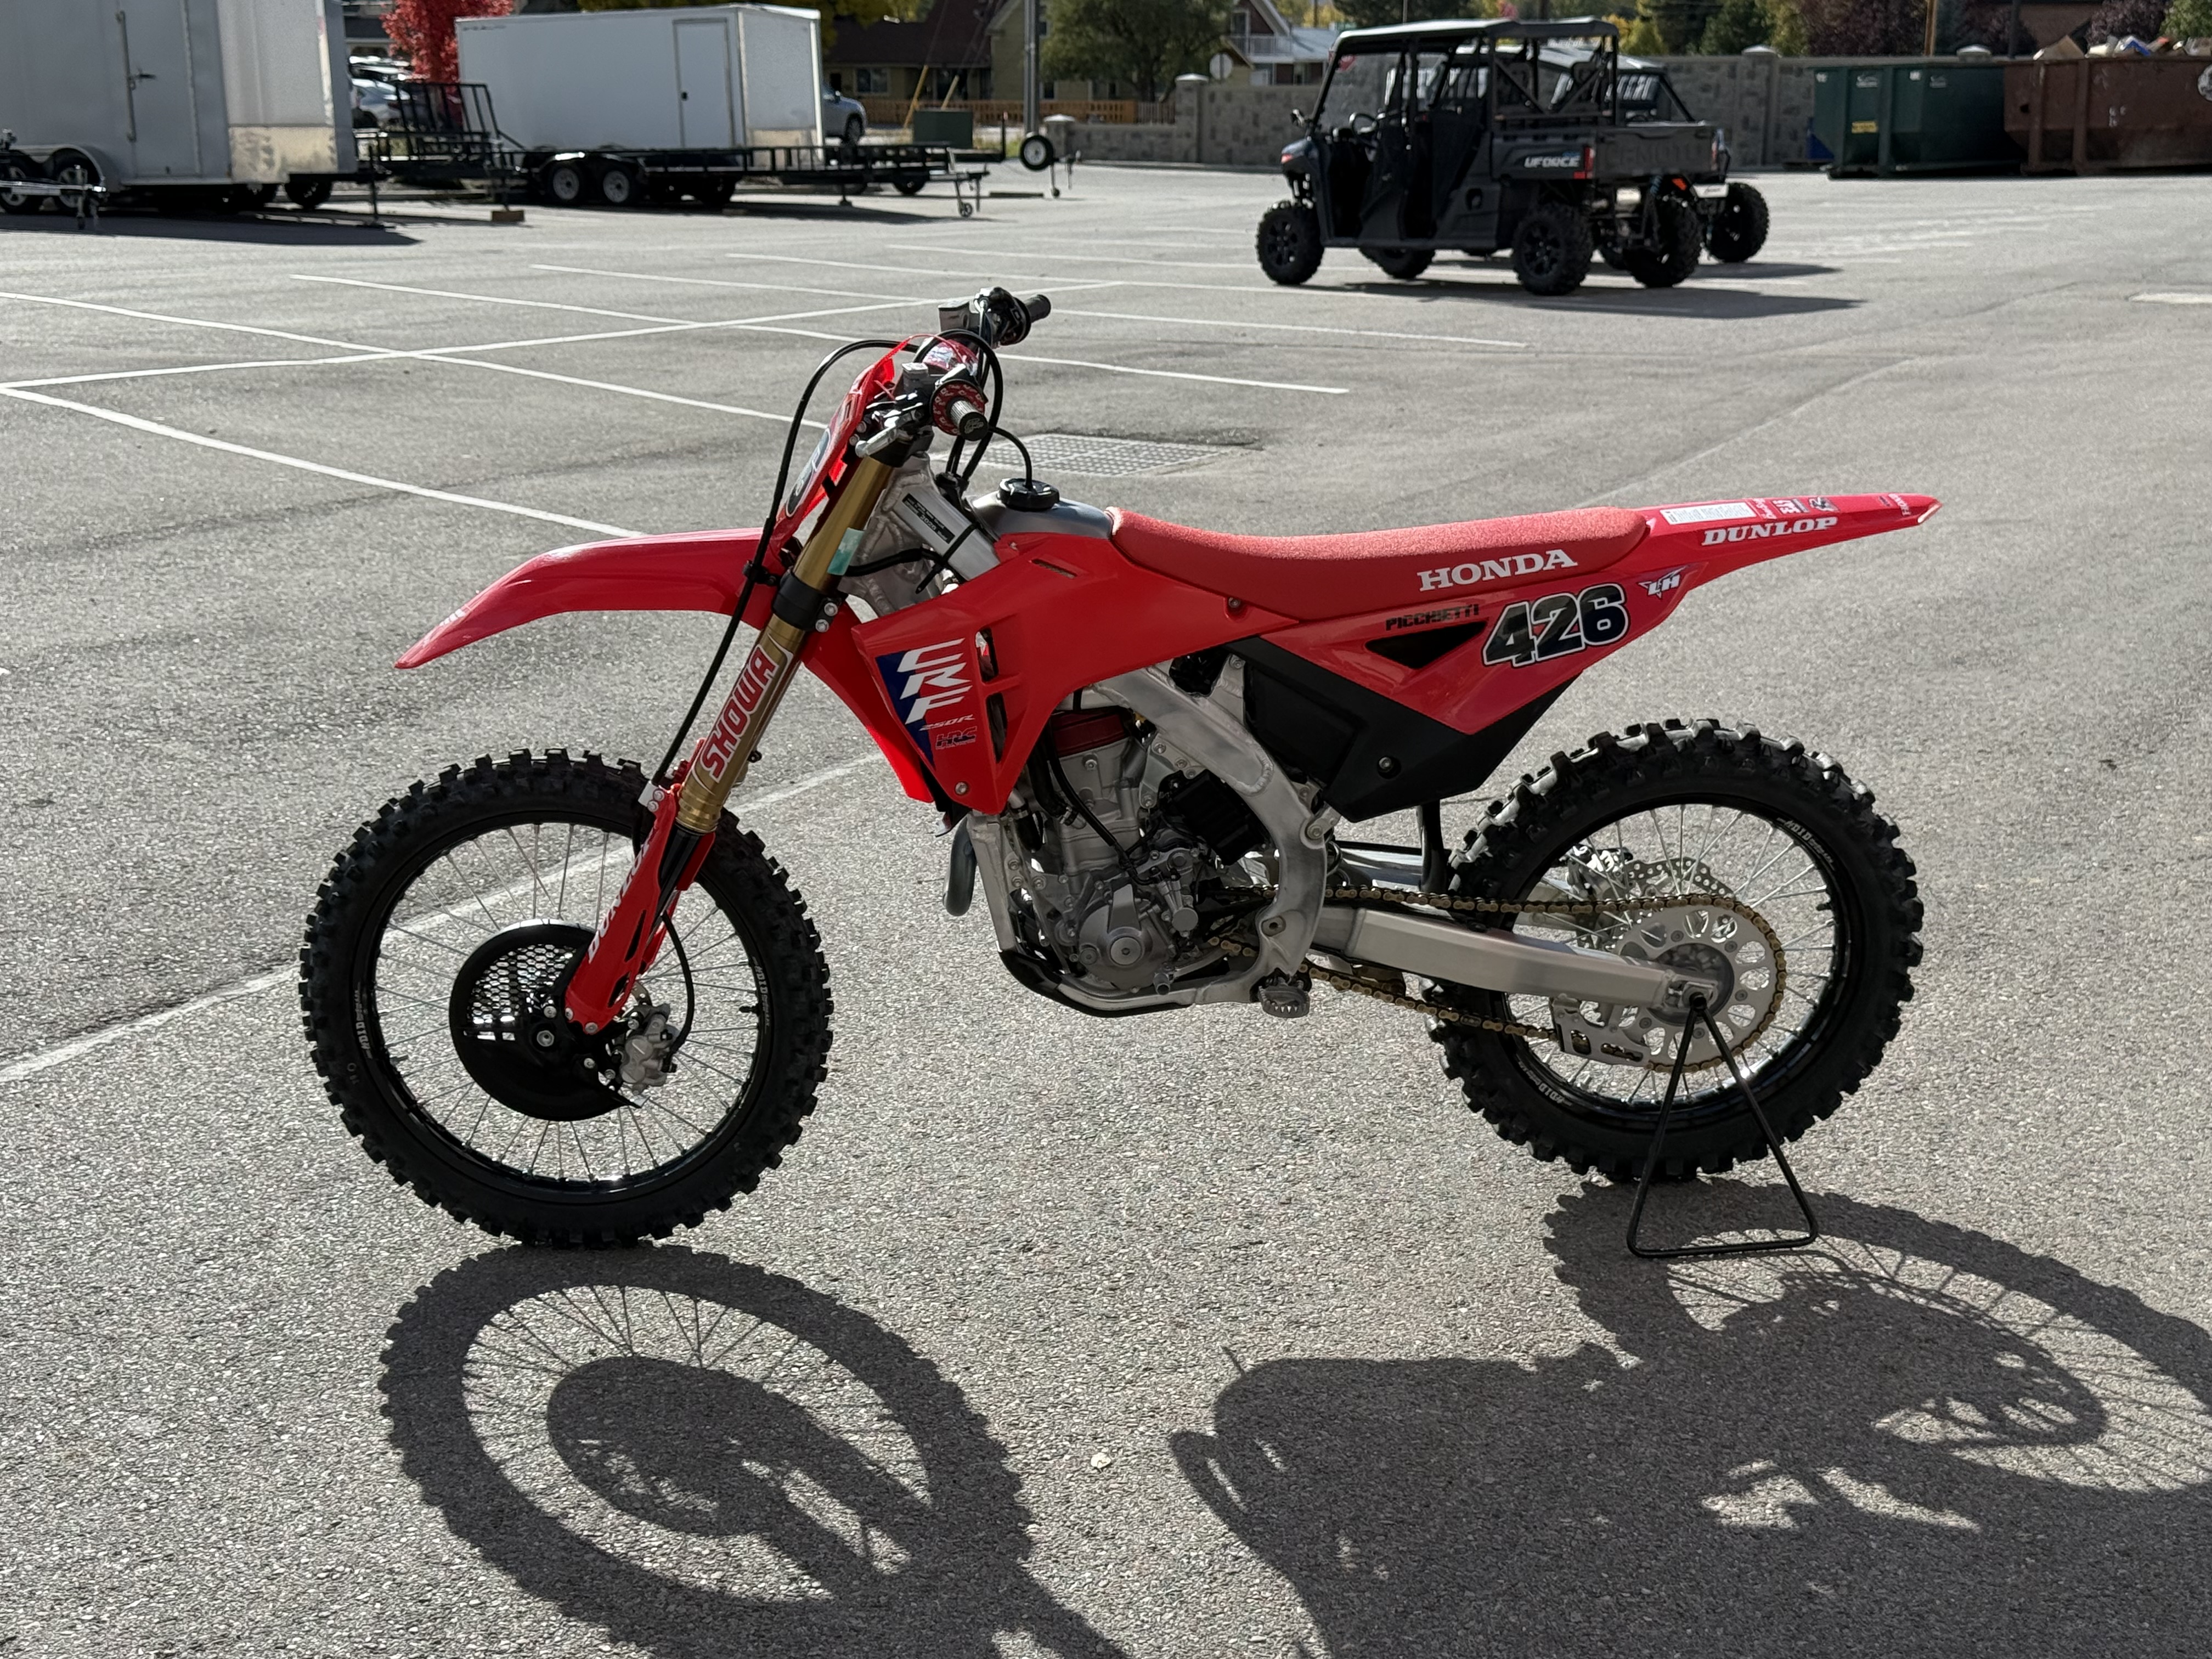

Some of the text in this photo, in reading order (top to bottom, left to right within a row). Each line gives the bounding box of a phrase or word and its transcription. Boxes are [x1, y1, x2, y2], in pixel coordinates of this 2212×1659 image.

[1524, 156, 1581, 168] UFORCE
[1701, 516, 1838, 546] DUNLOP
[1417, 549, 1578, 592] HONDA
[1482, 583, 1629, 668] 426
[897, 637, 973, 725] CRF
[700, 644, 779, 783] SHOWA
